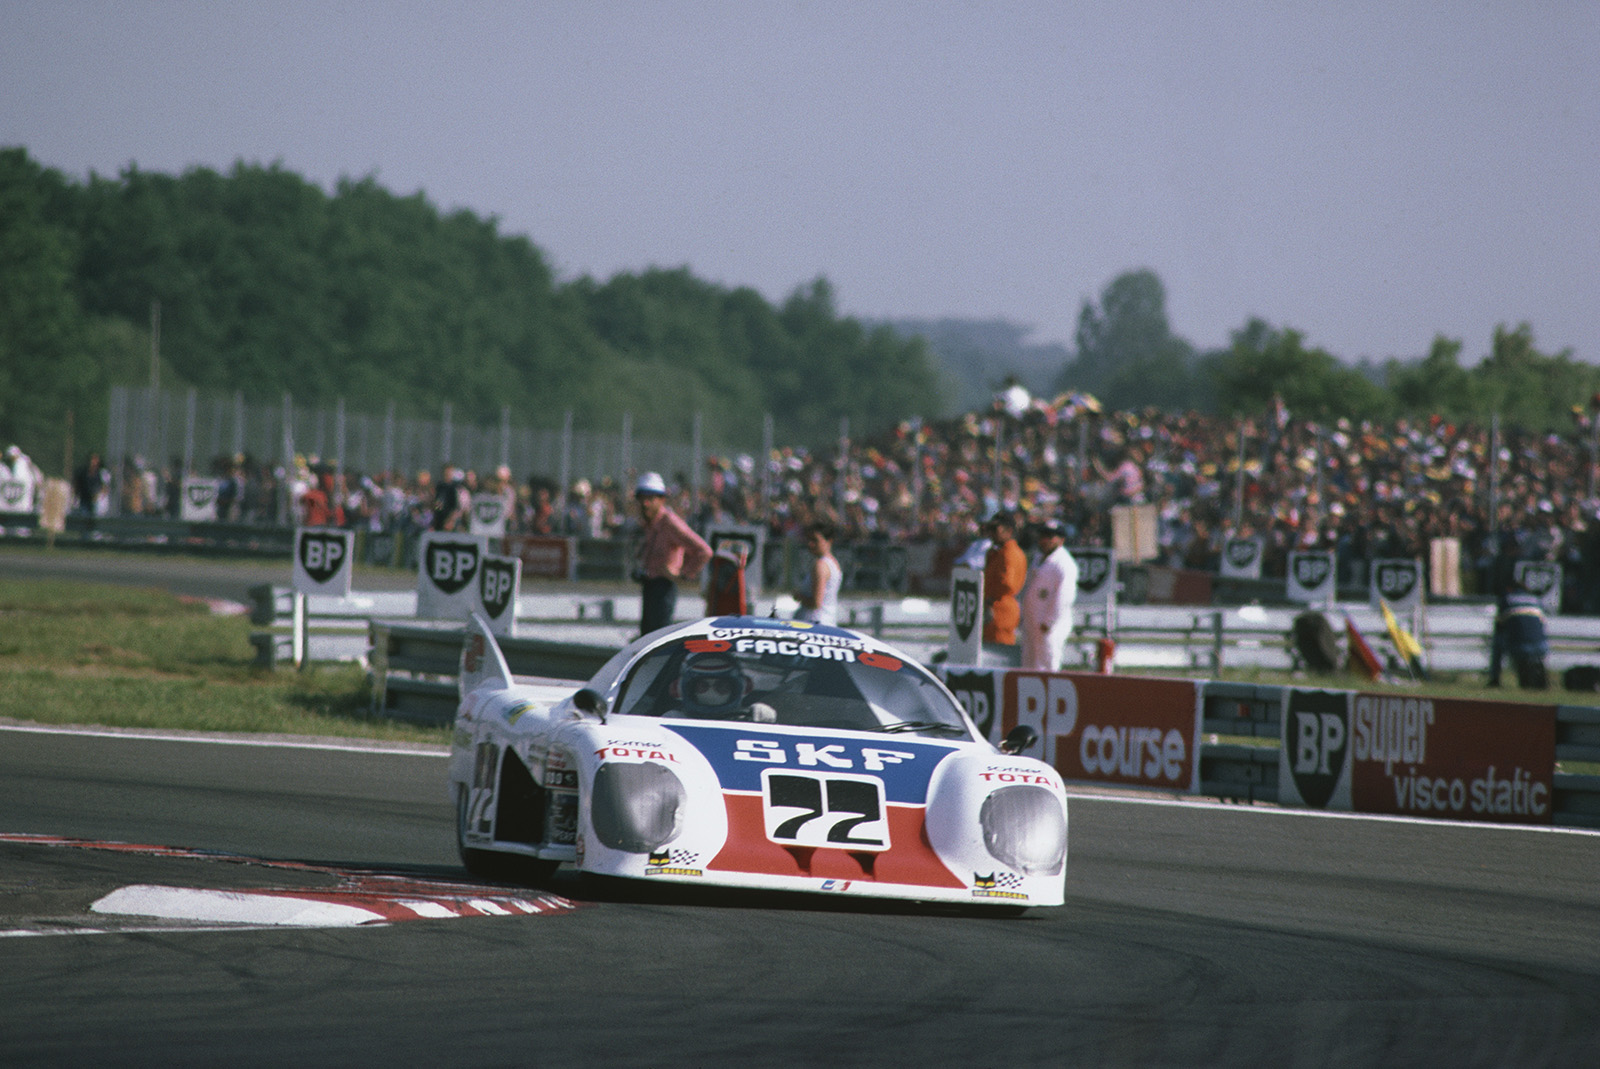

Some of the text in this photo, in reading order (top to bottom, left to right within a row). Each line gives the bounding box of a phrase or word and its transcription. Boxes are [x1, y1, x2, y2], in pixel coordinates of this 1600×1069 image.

[306, 540, 343, 571] BP
[433, 550, 475, 582] BP
[1077, 558, 1106, 582] BP
[1299, 559, 1328, 579] BP
[485, 569, 511, 604] BP
[1381, 568, 1412, 593] BP
[957, 589, 975, 626] BP
[736, 639, 855, 662] FACOM
[1017, 676, 1078, 769] BP
[1354, 697, 1435, 776] super
[593, 747, 681, 764] TOTAL
[733, 739, 915, 771] SKF
[1080, 724, 1185, 780] course
[1294, 711, 1345, 776] BP
[1393, 765, 1548, 816] visco static
[768, 775, 884, 846] 72
